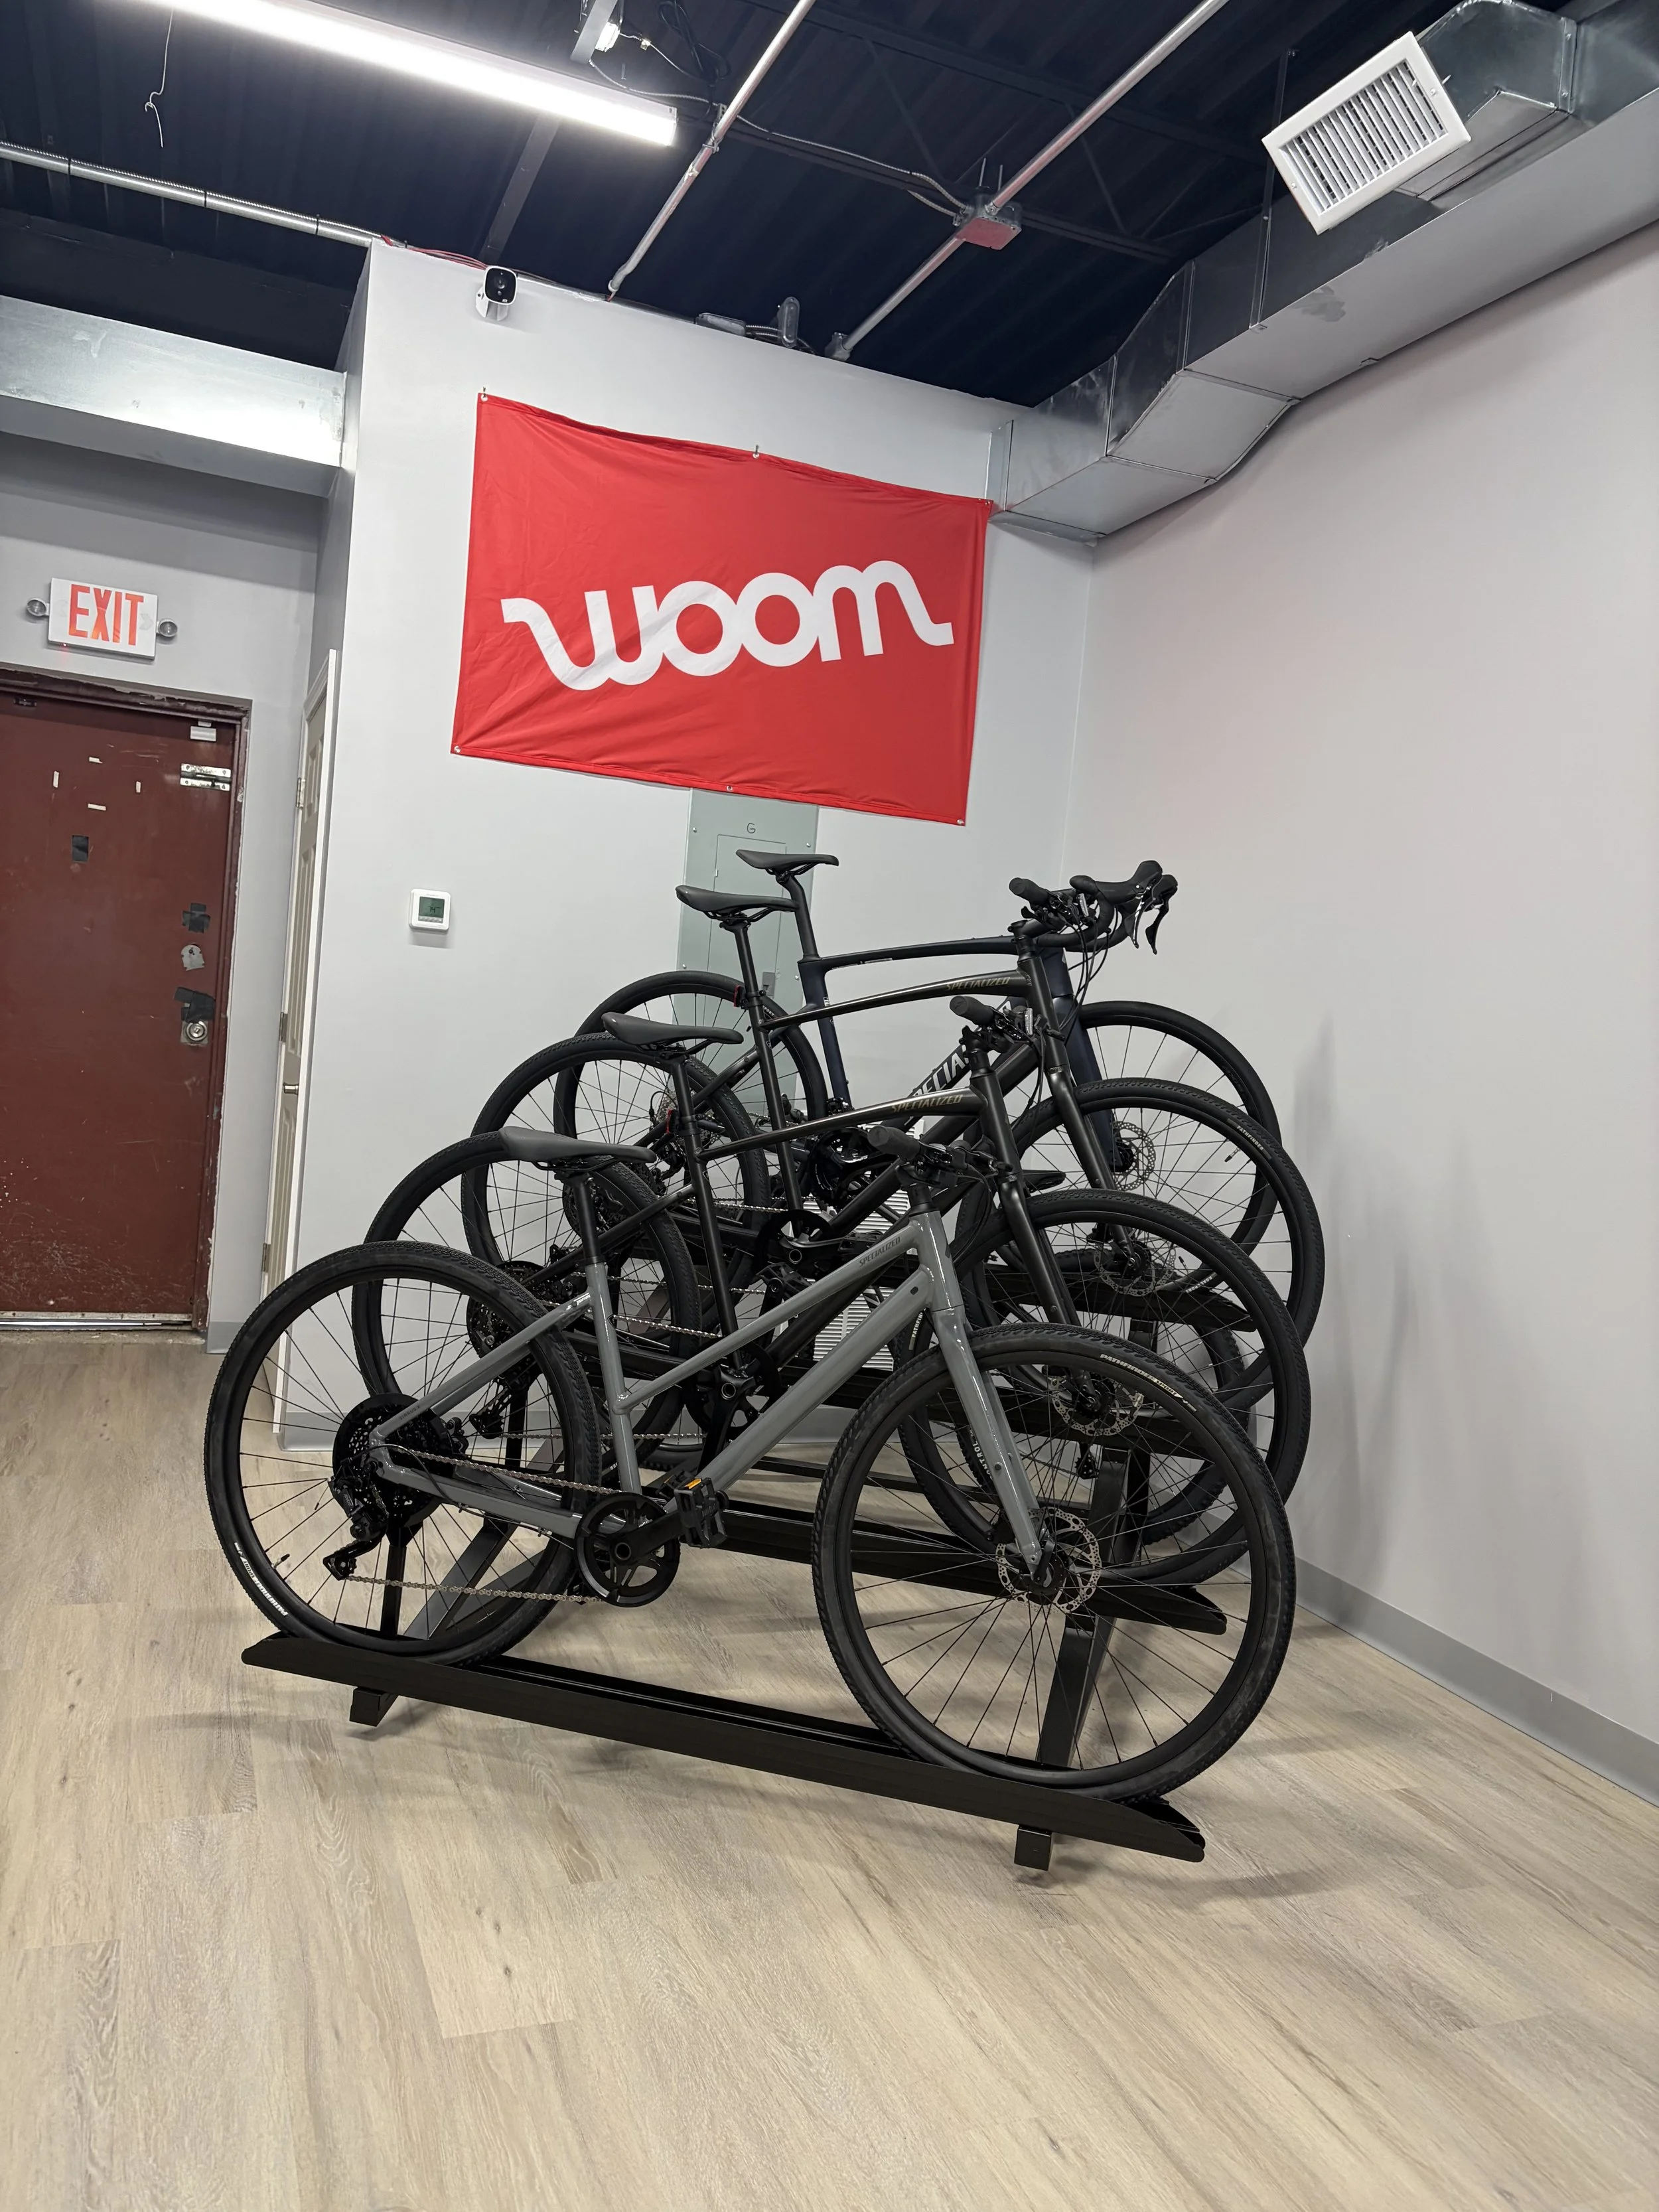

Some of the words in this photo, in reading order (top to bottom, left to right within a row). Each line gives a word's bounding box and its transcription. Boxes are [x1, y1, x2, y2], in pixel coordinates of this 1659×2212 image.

[68, 584, 145, 646] EXIT
[501, 560, 954, 690] woom
[747, 822, 756, 834] G
[946, 976, 1011, 991] SPECIALIZED
[891, 1094, 964, 1113] SPECIALIZED
[1236, 1125, 1264, 1150] PATHFINDER
[859, 1236, 901, 1268] SPECIALIZED
[911, 1311, 924, 1338] PATHFIN
[1100, 1353, 1156, 1383] PATHFINDER
[973, 1440, 993, 1480] ONTROL
